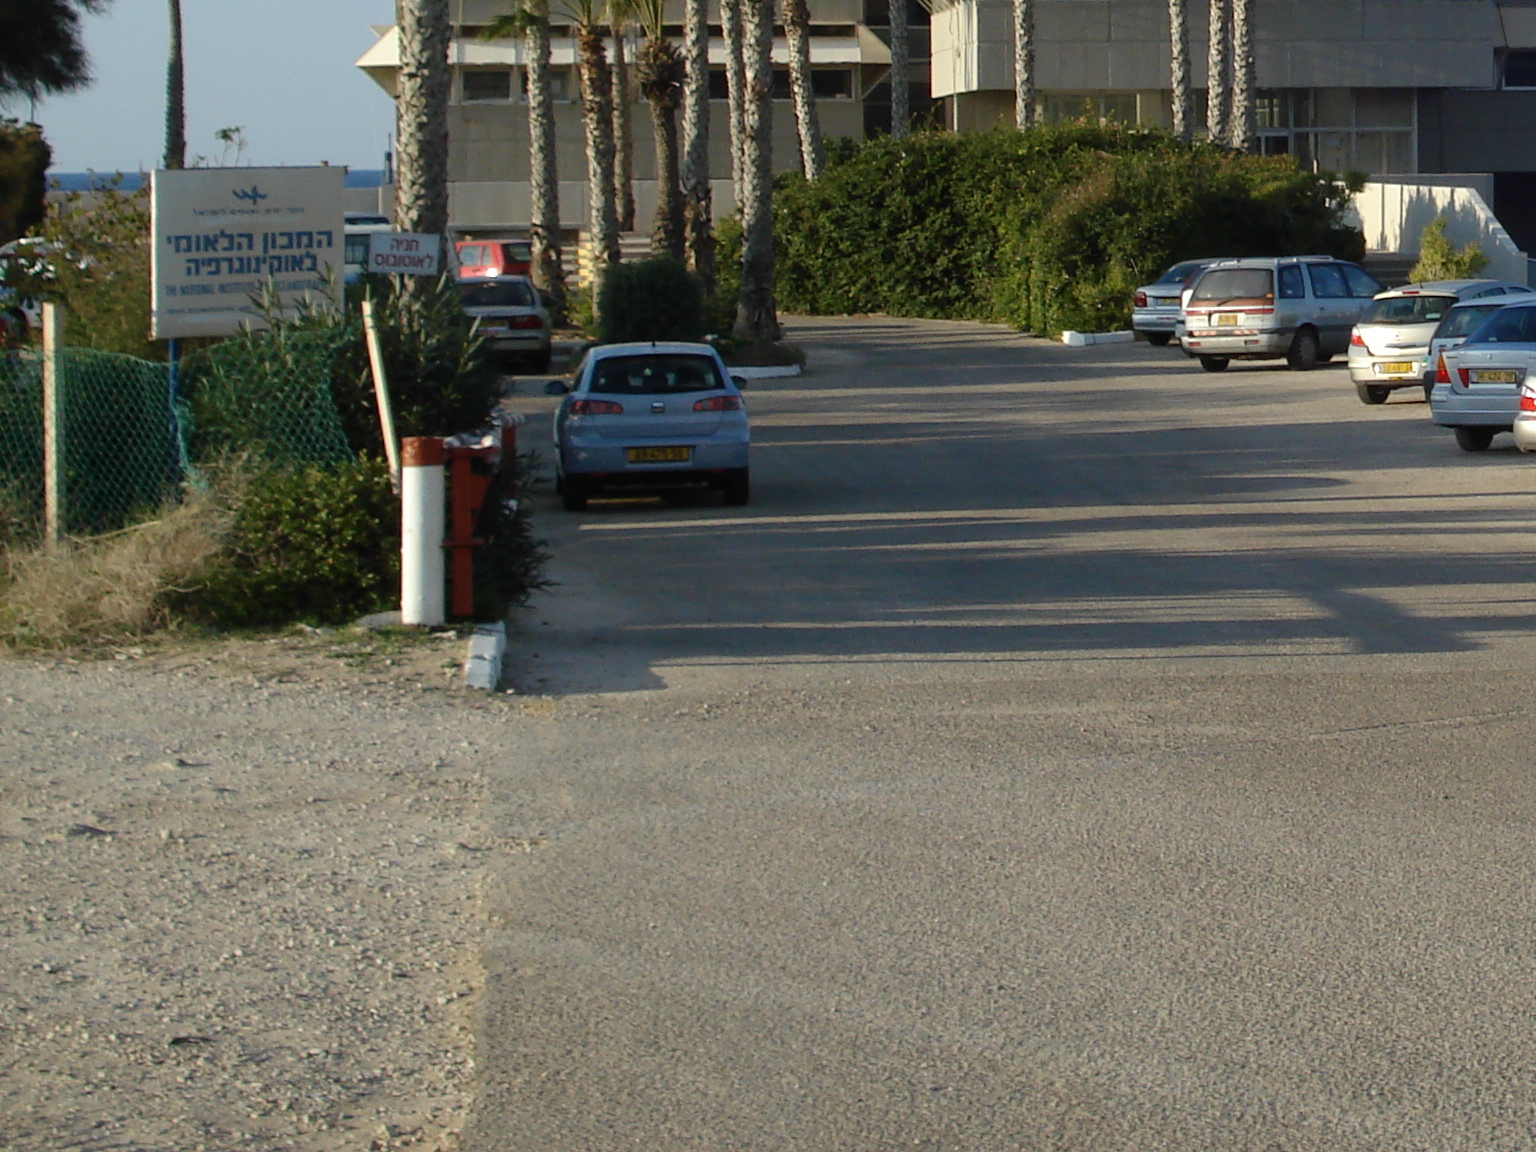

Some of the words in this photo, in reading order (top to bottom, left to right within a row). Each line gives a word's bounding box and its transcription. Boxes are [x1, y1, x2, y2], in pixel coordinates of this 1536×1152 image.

[166, 229, 253, 253] הלאומי
[262, 230, 333, 254] המכון
[390, 238, 419, 252] חניה
[185, 251, 318, 276] לאוקינוגרפיה
